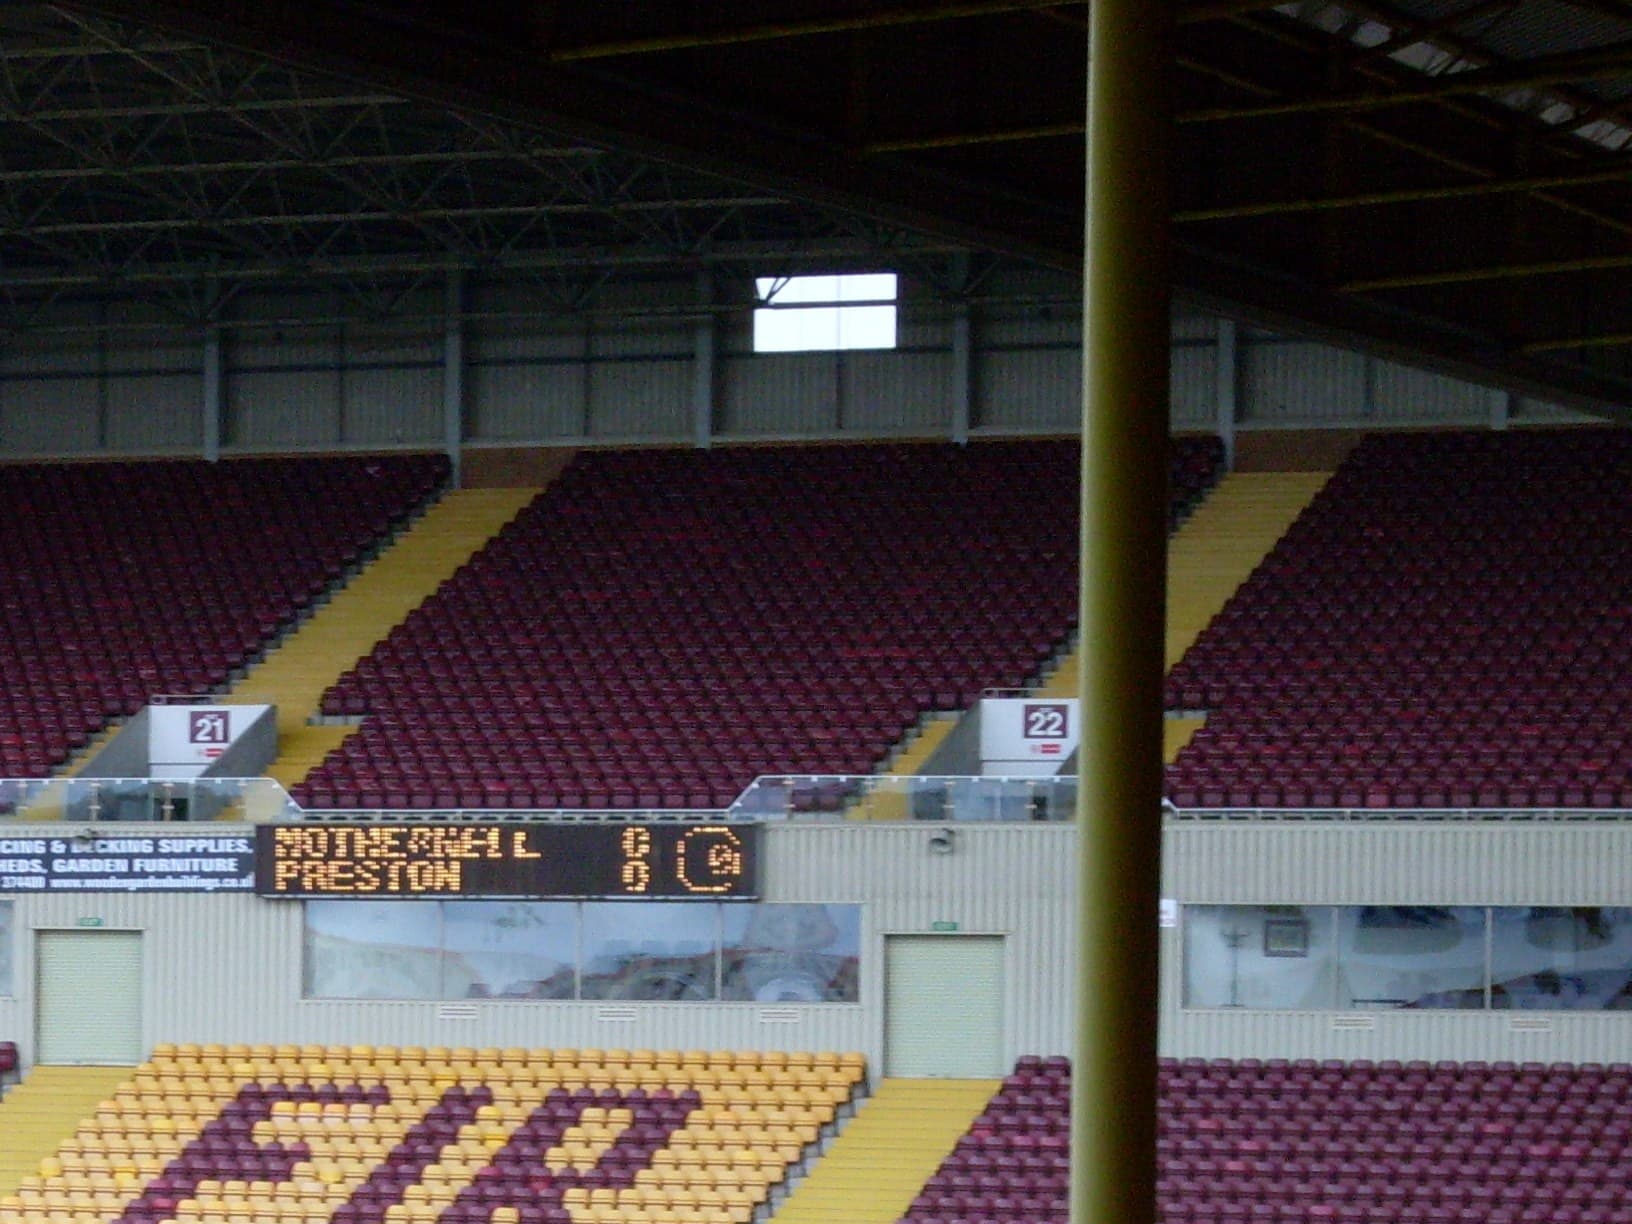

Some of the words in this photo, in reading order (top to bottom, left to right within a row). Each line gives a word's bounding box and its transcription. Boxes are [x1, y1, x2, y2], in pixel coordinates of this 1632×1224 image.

[194, 718, 225, 741] 21
[1027, 712, 1064, 736] 22
[50, 839, 67, 854] &
[51, 857, 129, 873] GARDEN
[132, 857, 239, 873] FURNITURE
[273, 860, 462, 892] PRESTON
